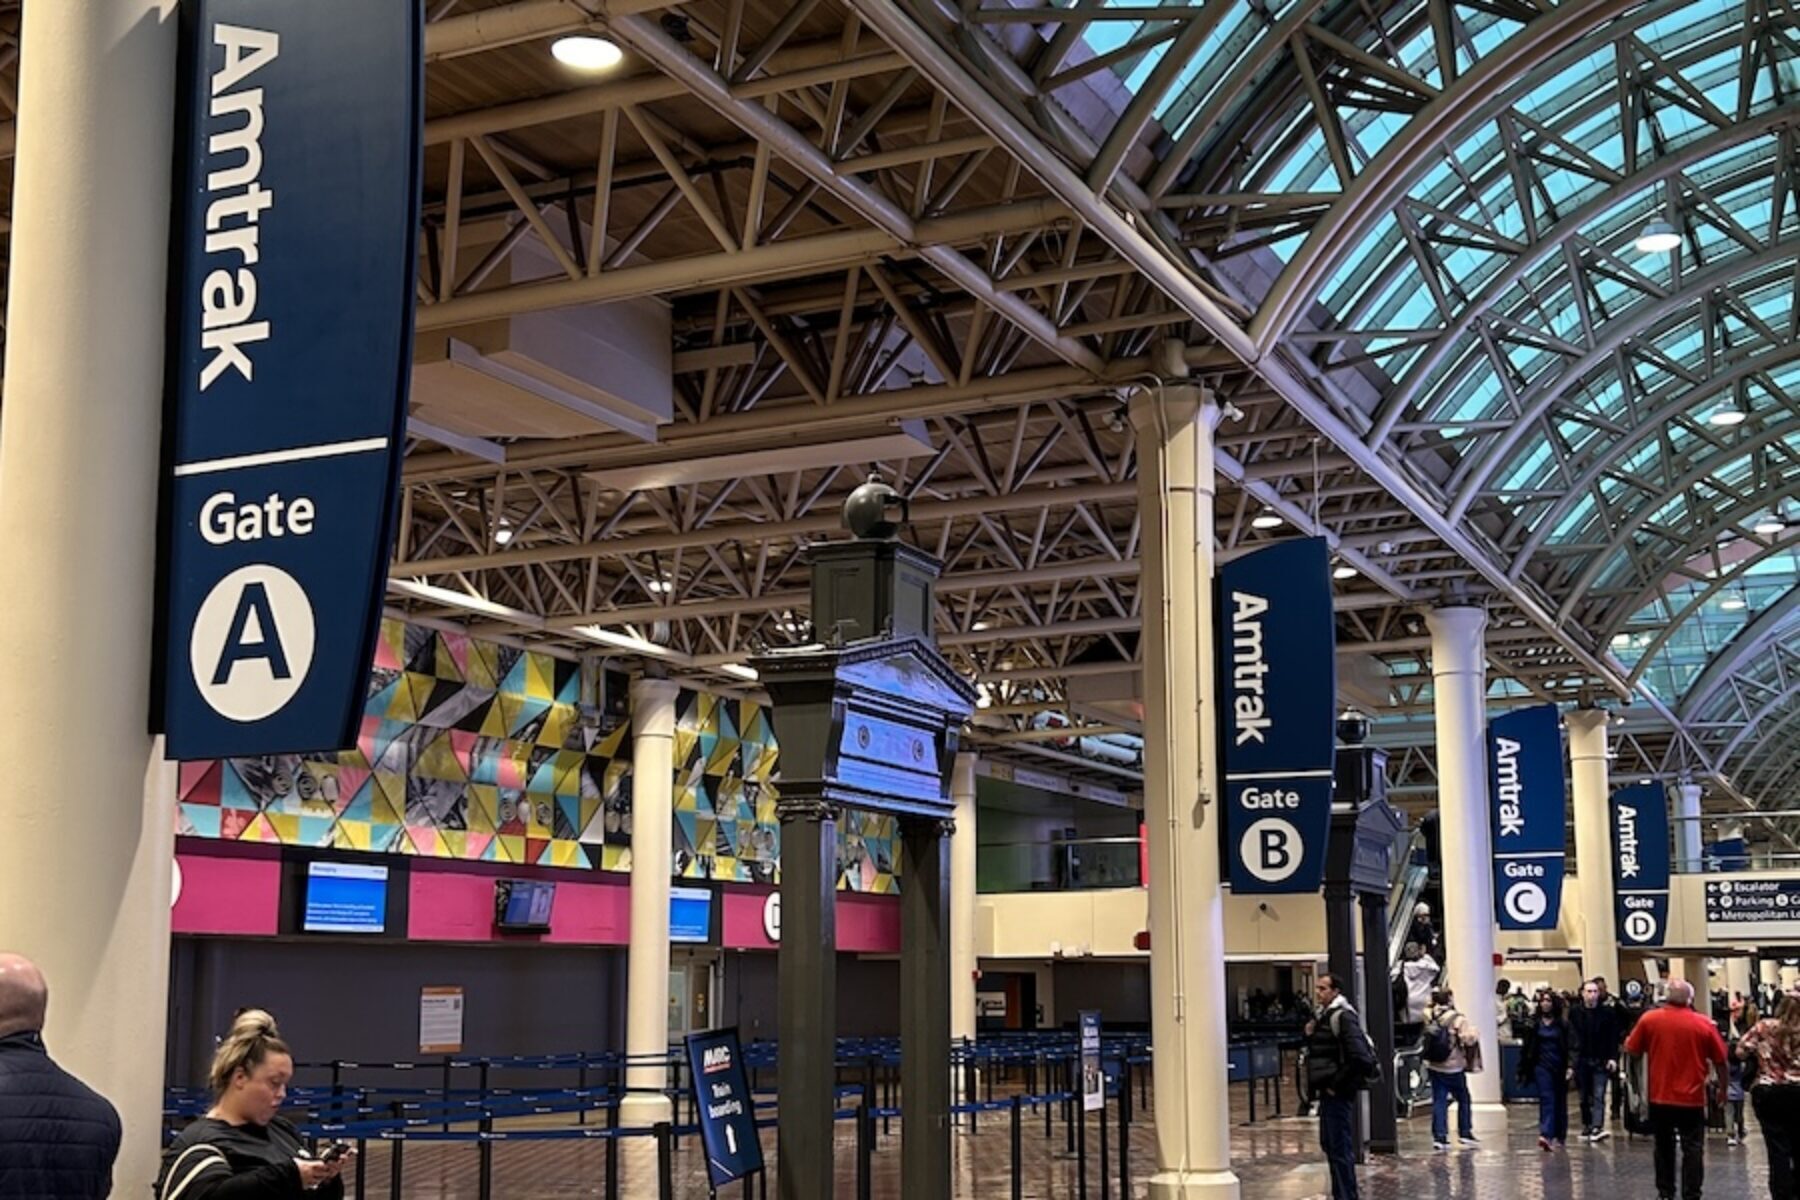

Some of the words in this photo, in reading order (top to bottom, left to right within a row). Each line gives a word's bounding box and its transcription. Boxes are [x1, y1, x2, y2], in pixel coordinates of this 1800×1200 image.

[199, 22, 280, 392] Amtrak
[199, 491, 315, 545] Gate
[211, 581, 292, 686] A
[1232, 591, 1272, 746] Amtrak
[1240, 787, 1300, 809] Gate
[1495, 737, 1525, 836] Amtrak
[1259, 829, 1290, 870] B
[1617, 804, 1641, 879] Amtrak
[1503, 861, 1544, 878] Gate
[1734, 882, 1779, 892] Escalator
[1513, 889, 1533, 915] C
[1623, 896, 1655, 909] Gate
[1721, 910, 1788, 920] Metropolitan
[1735, 896, 1774, 908] Parking
[1633, 916, 1650, 935] D
